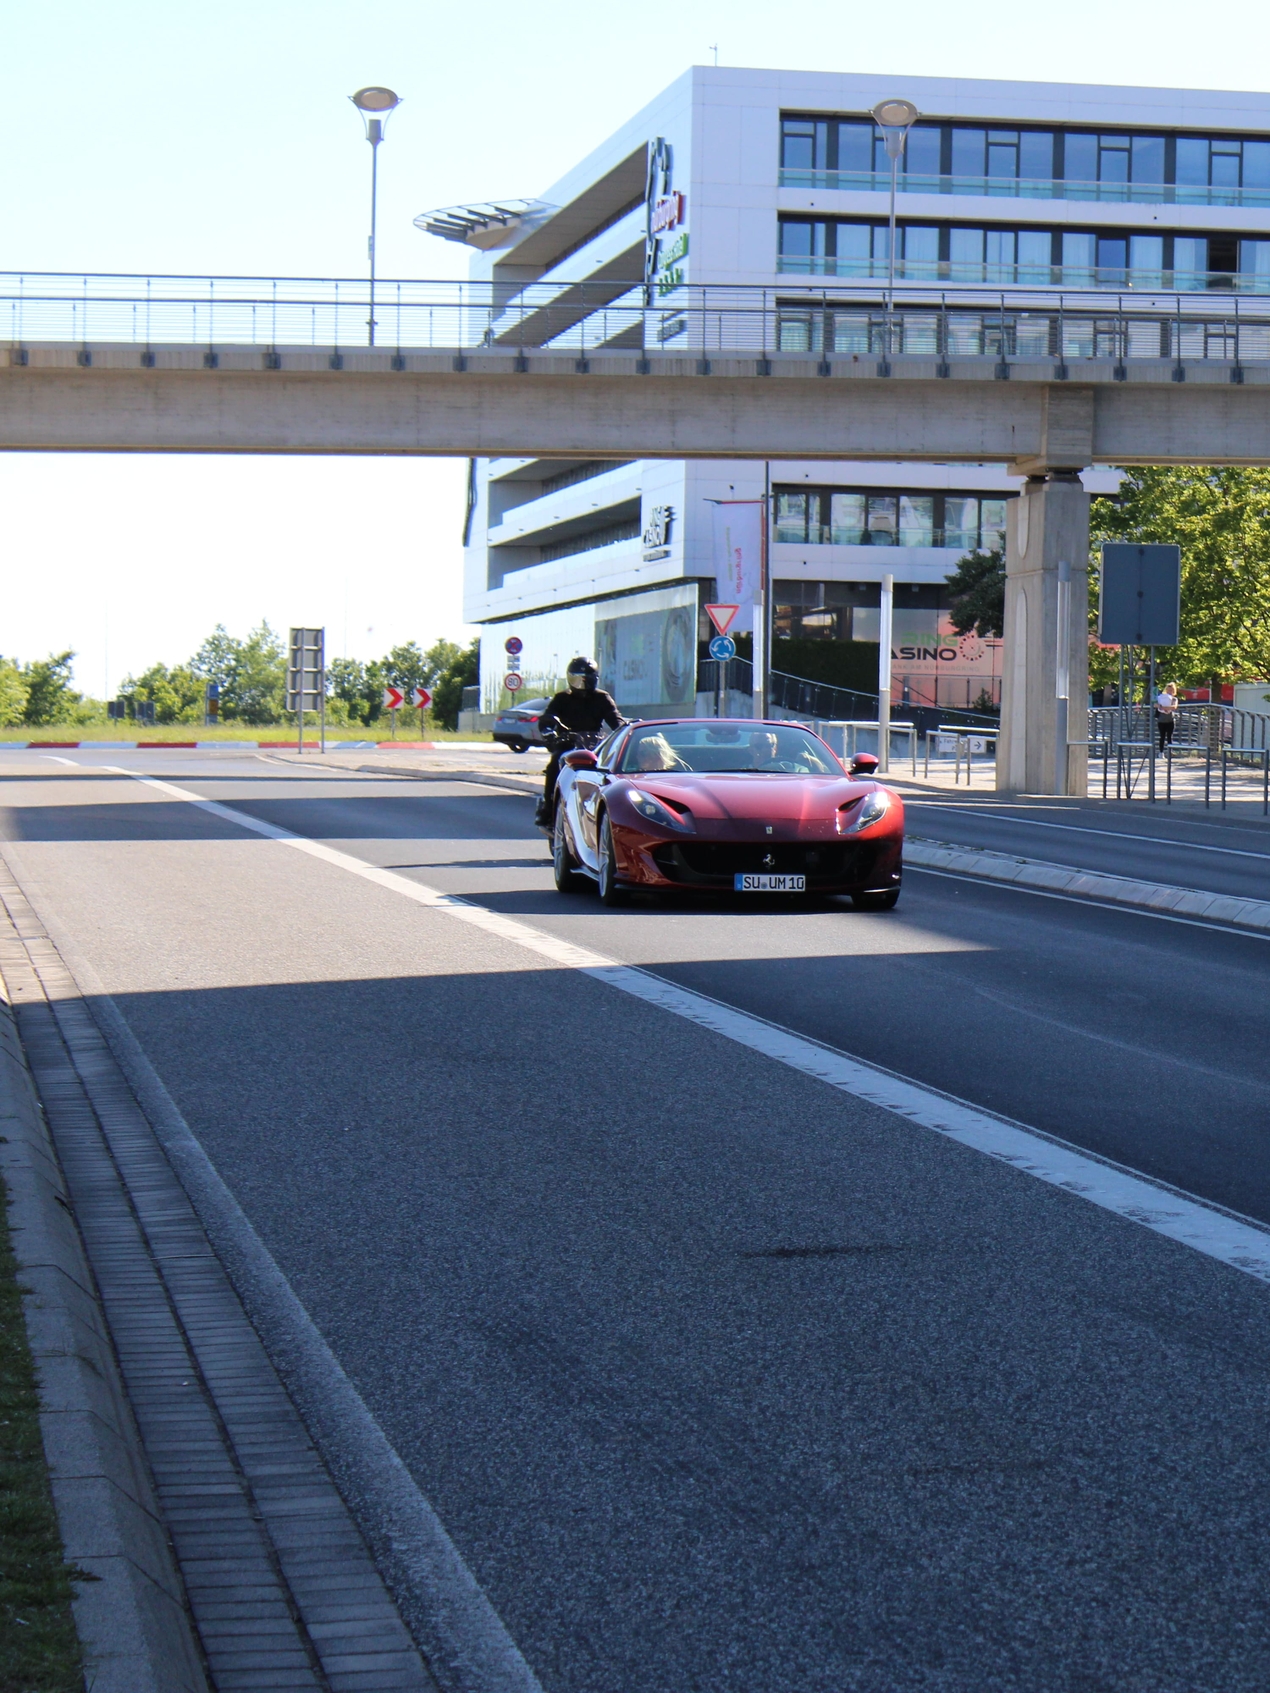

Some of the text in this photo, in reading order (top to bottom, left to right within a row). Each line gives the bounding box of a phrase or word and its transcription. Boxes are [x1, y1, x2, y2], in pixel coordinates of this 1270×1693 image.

[901, 631, 958, 647] RING
[743, 876, 804, 890] SU UM 10
